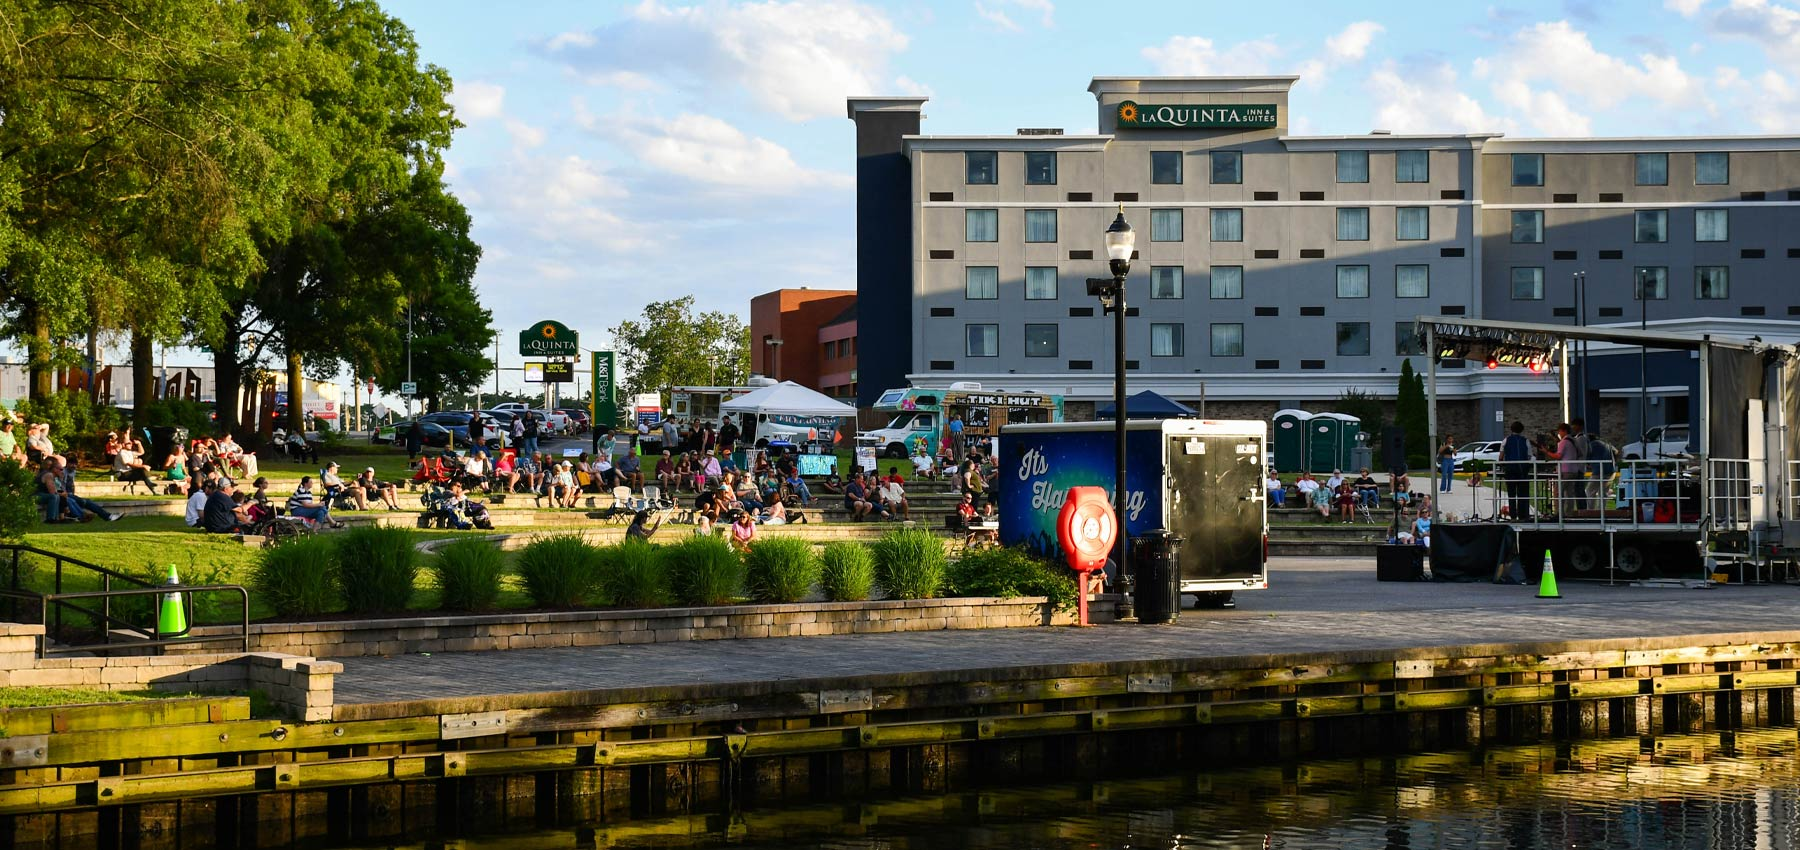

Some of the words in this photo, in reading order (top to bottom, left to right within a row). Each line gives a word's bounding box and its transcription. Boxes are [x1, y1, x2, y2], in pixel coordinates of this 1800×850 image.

[599, 356, 609, 380] M&T
[599, 381, 609, 403] Bank
[968, 395, 1004, 405] TIKI
[1007, 396, 1041, 406] HUT
[1018, 444, 1049, 481] It's
